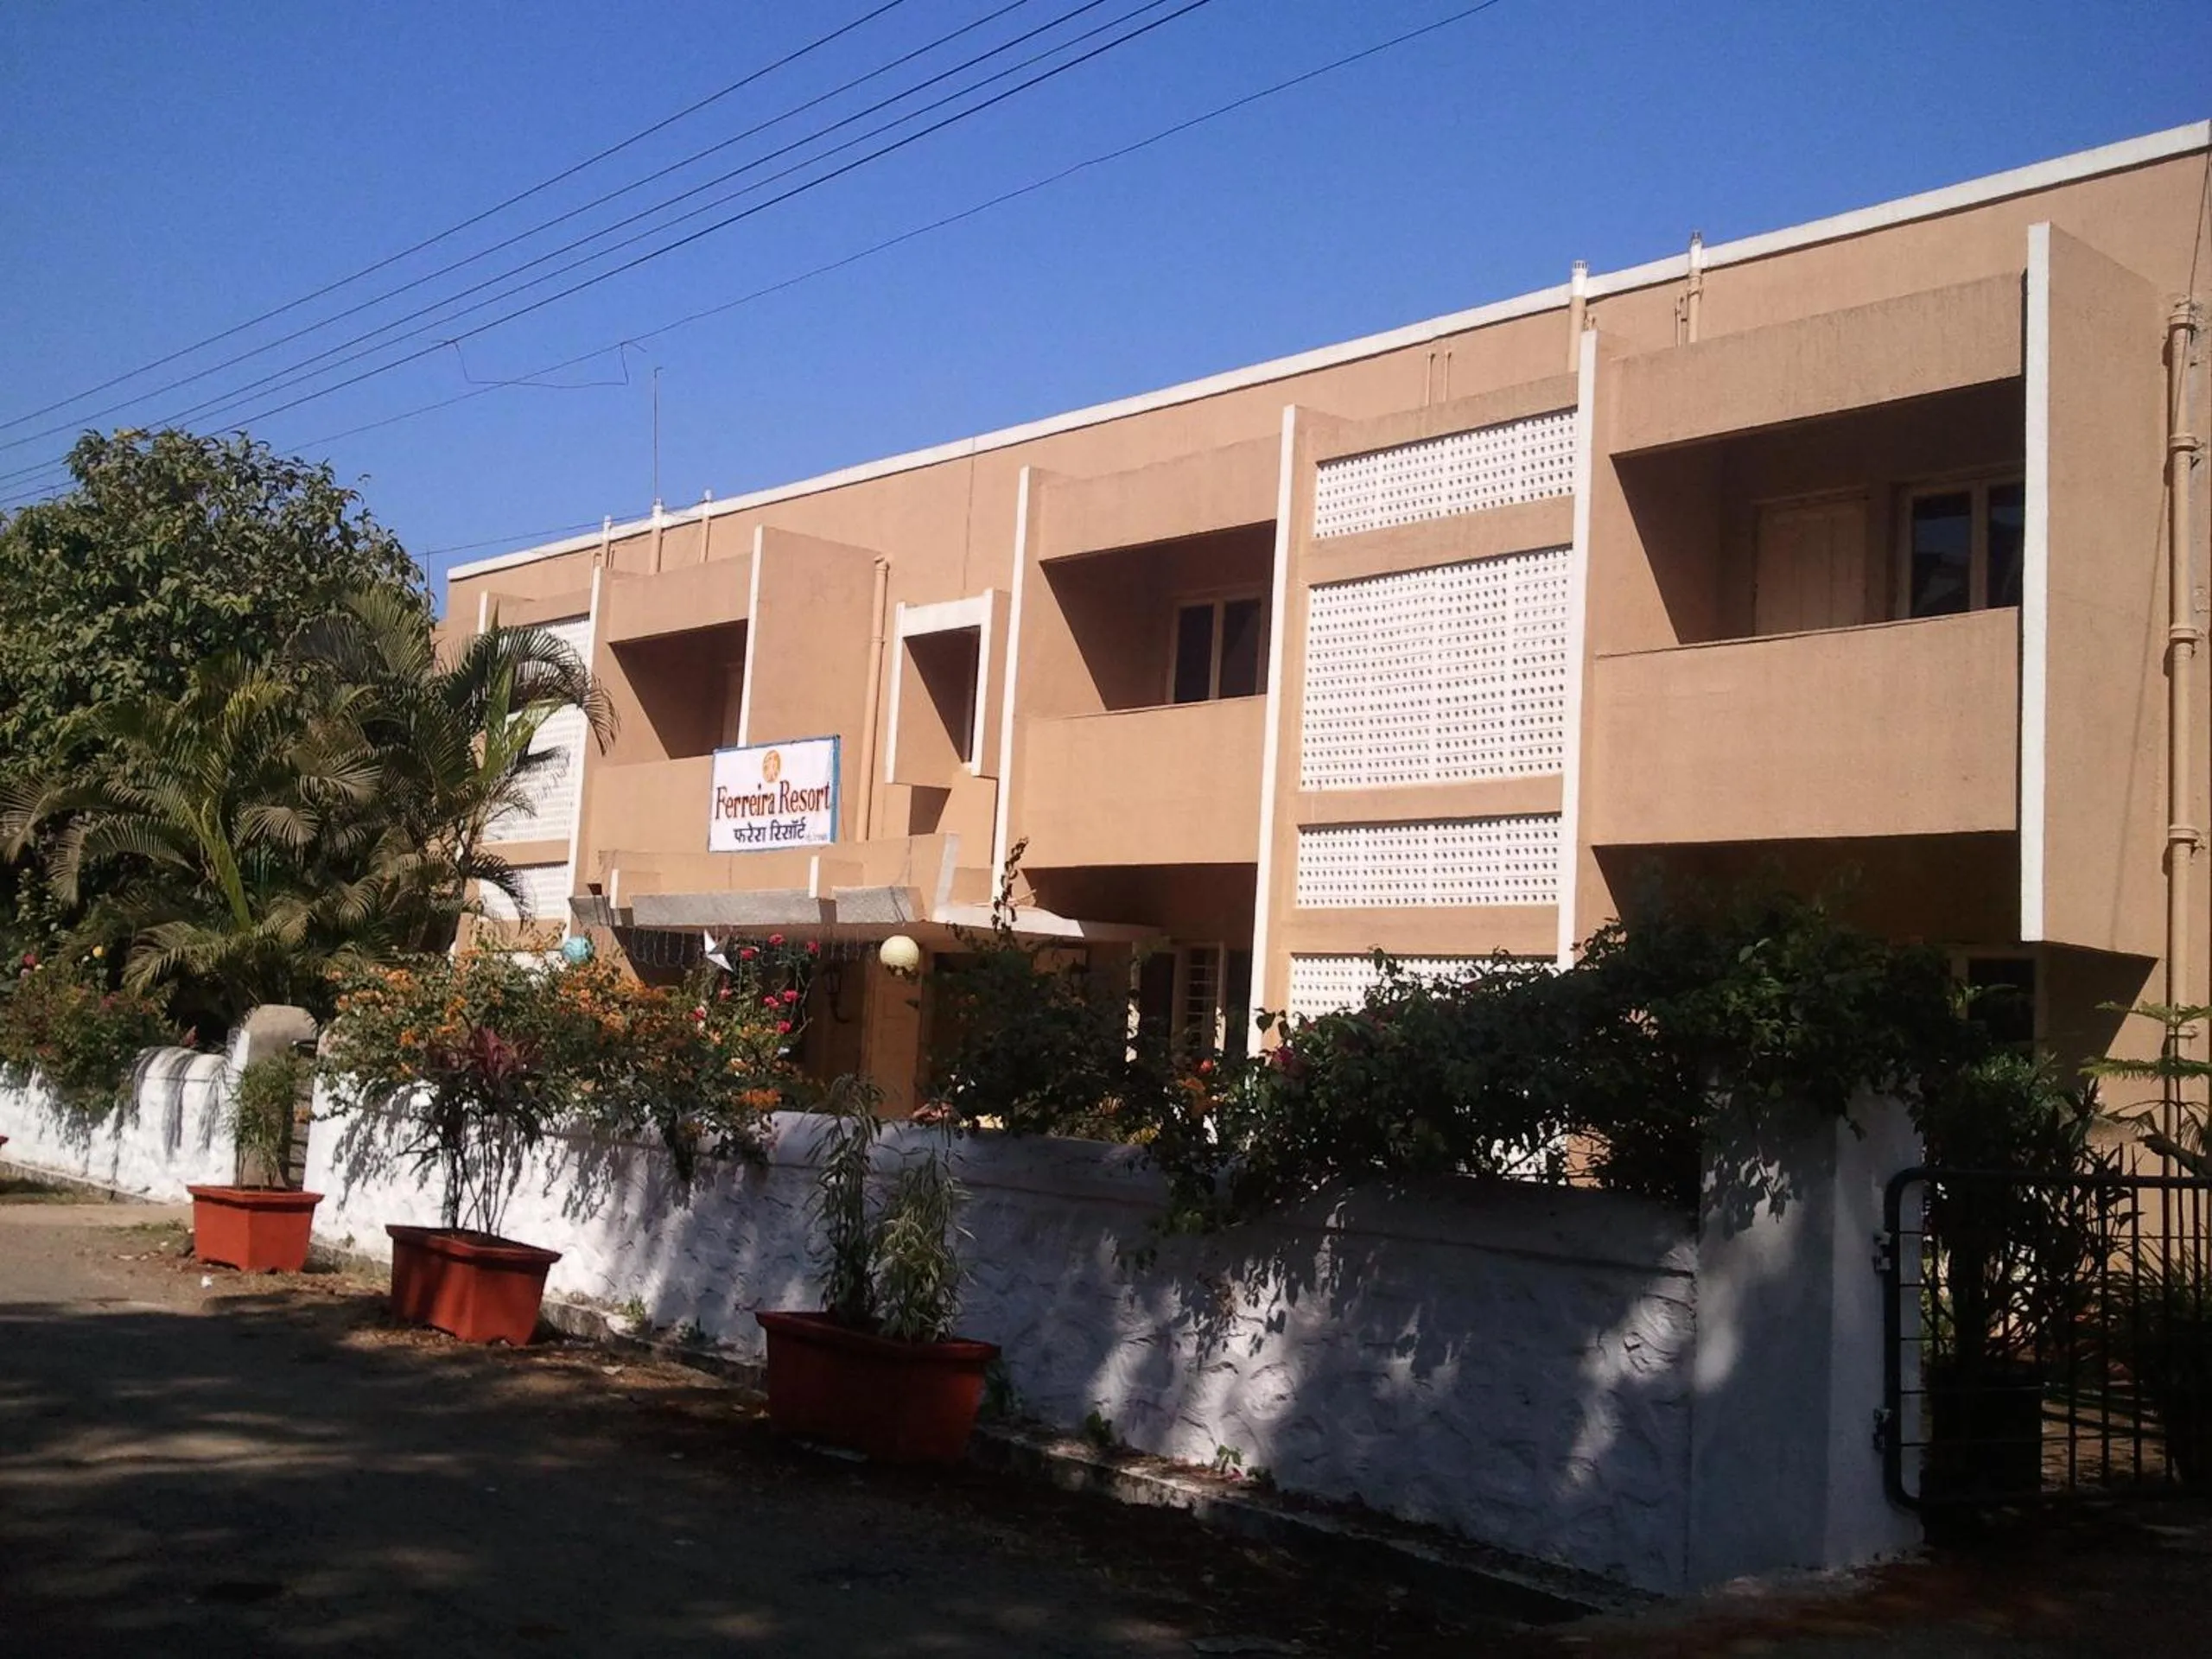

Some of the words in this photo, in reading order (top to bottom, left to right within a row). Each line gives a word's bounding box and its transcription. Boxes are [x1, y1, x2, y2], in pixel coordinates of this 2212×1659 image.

[715, 783, 775, 820] Ferreira
[779, 779, 830, 814] Resort
[733, 821, 766, 843] फरेरा
[769, 817, 806, 841] रिसॉर्ट
